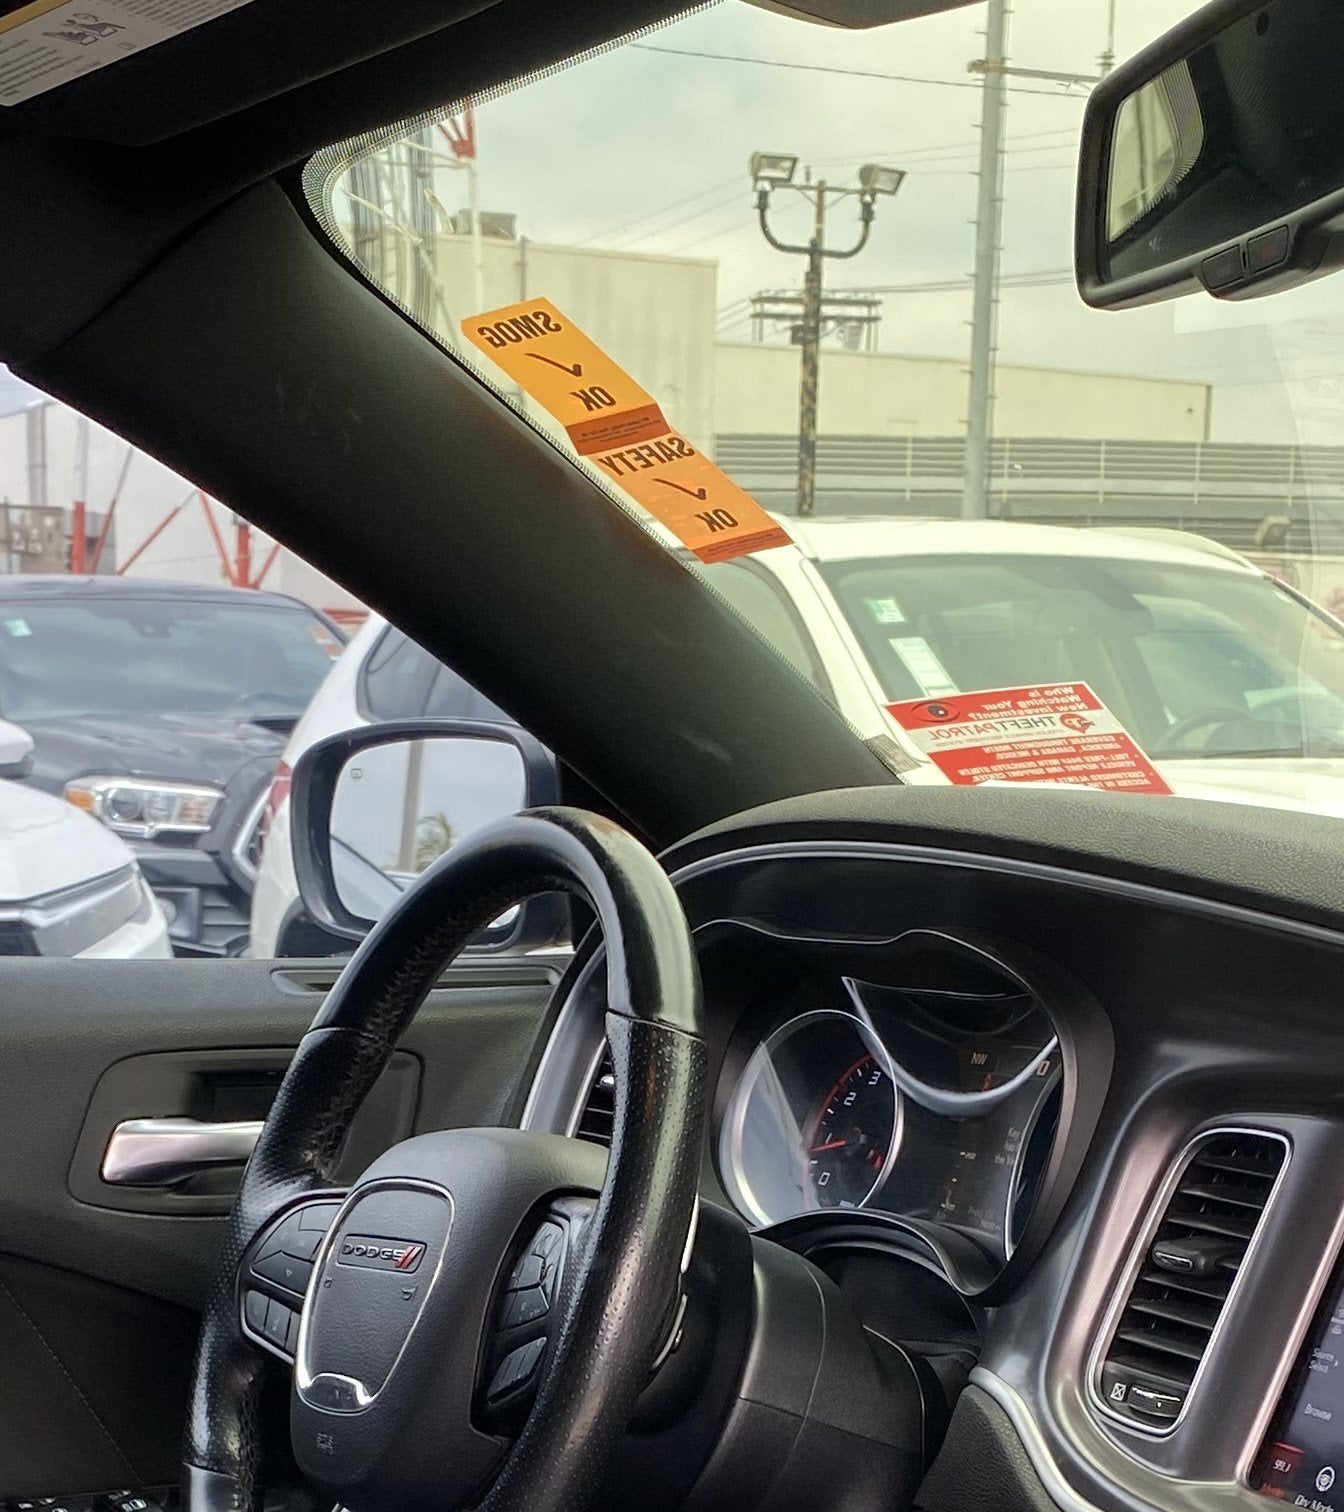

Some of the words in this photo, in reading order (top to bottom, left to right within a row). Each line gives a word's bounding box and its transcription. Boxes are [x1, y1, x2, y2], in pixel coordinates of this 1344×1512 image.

[868, 1070, 882, 1086] 3
[843, 1091, 857, 1107] 2
[818, 1171, 831, 1187] 0
[342, 1243, 405, 1262] DODGE
[1304, 1402, 1333, 1421] Browse
[1294, 1494, 1311, 1509] Drv
